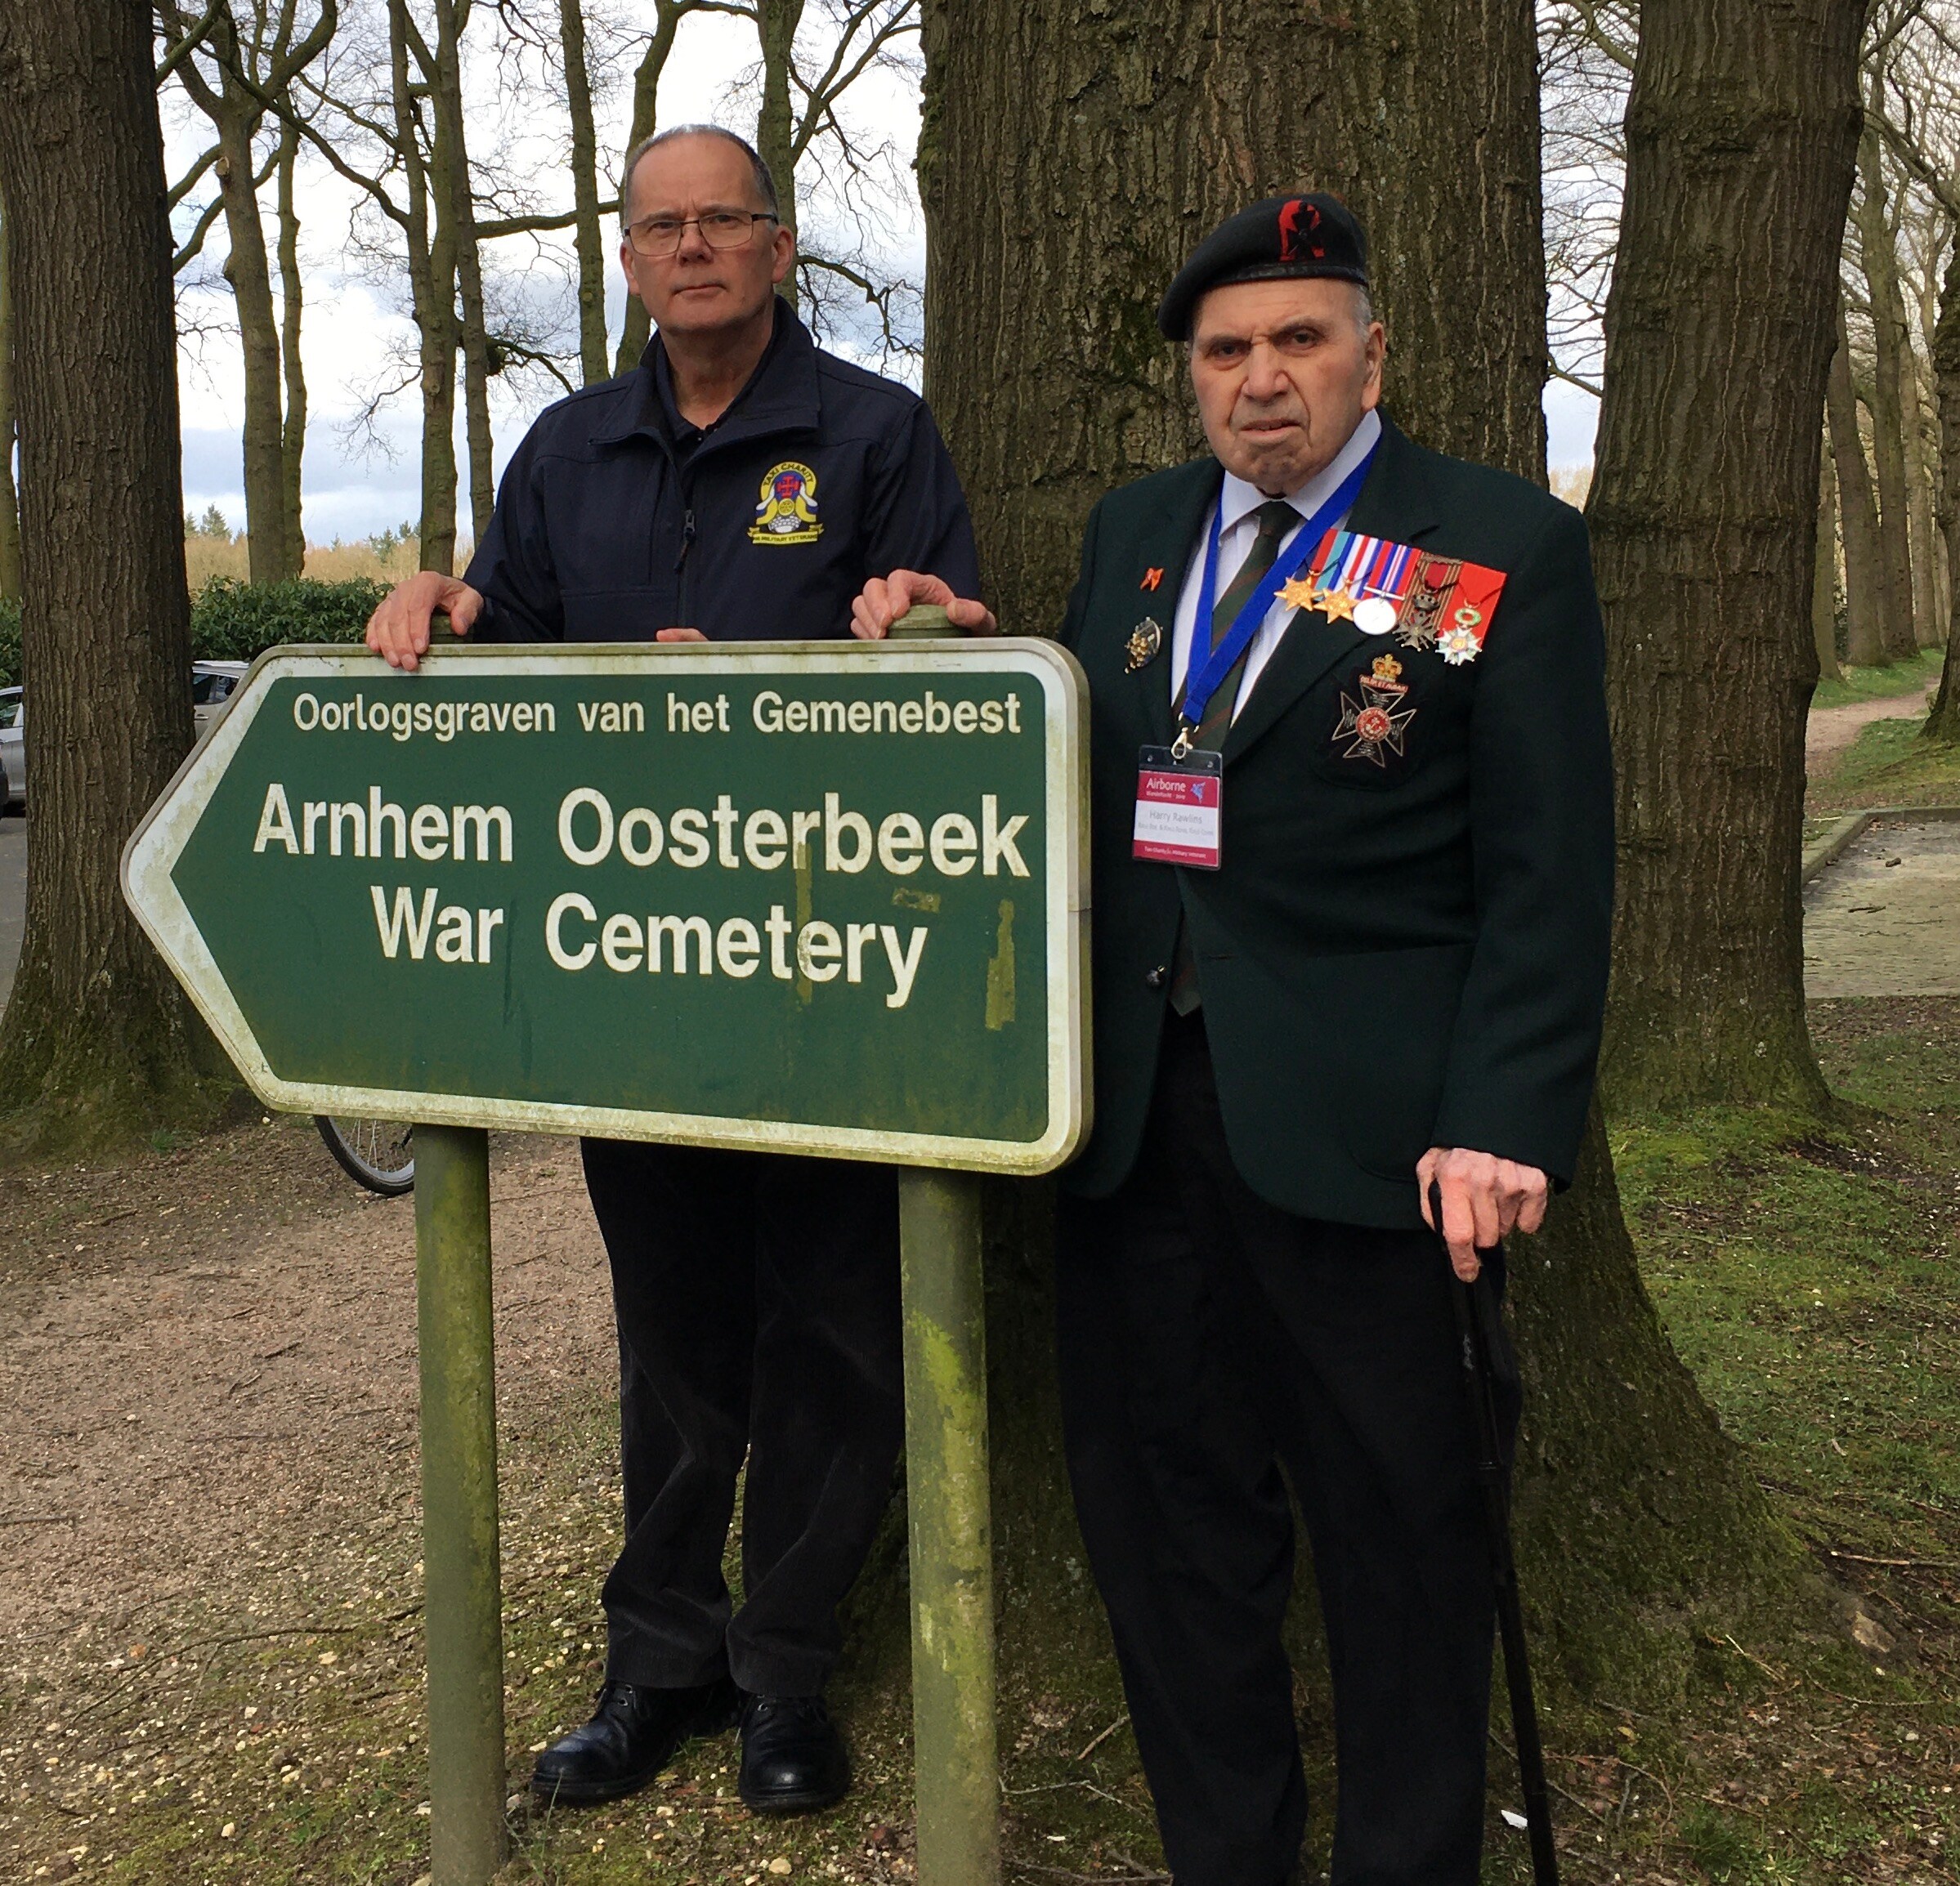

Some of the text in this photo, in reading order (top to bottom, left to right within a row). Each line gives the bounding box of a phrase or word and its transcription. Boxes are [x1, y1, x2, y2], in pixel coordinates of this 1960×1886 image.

[762, 463, 814, 486] TAXI CHARITY
[293, 690, 1022, 743] Oorlogsgraven van het Gemenebest
[1146, 778, 1186, 792] Airborne
[253, 782, 1031, 878] Arnhem Oosterbeek
[1149, 811, 1170, 822] Harry
[369, 884, 929, 1009] War Cemetery
